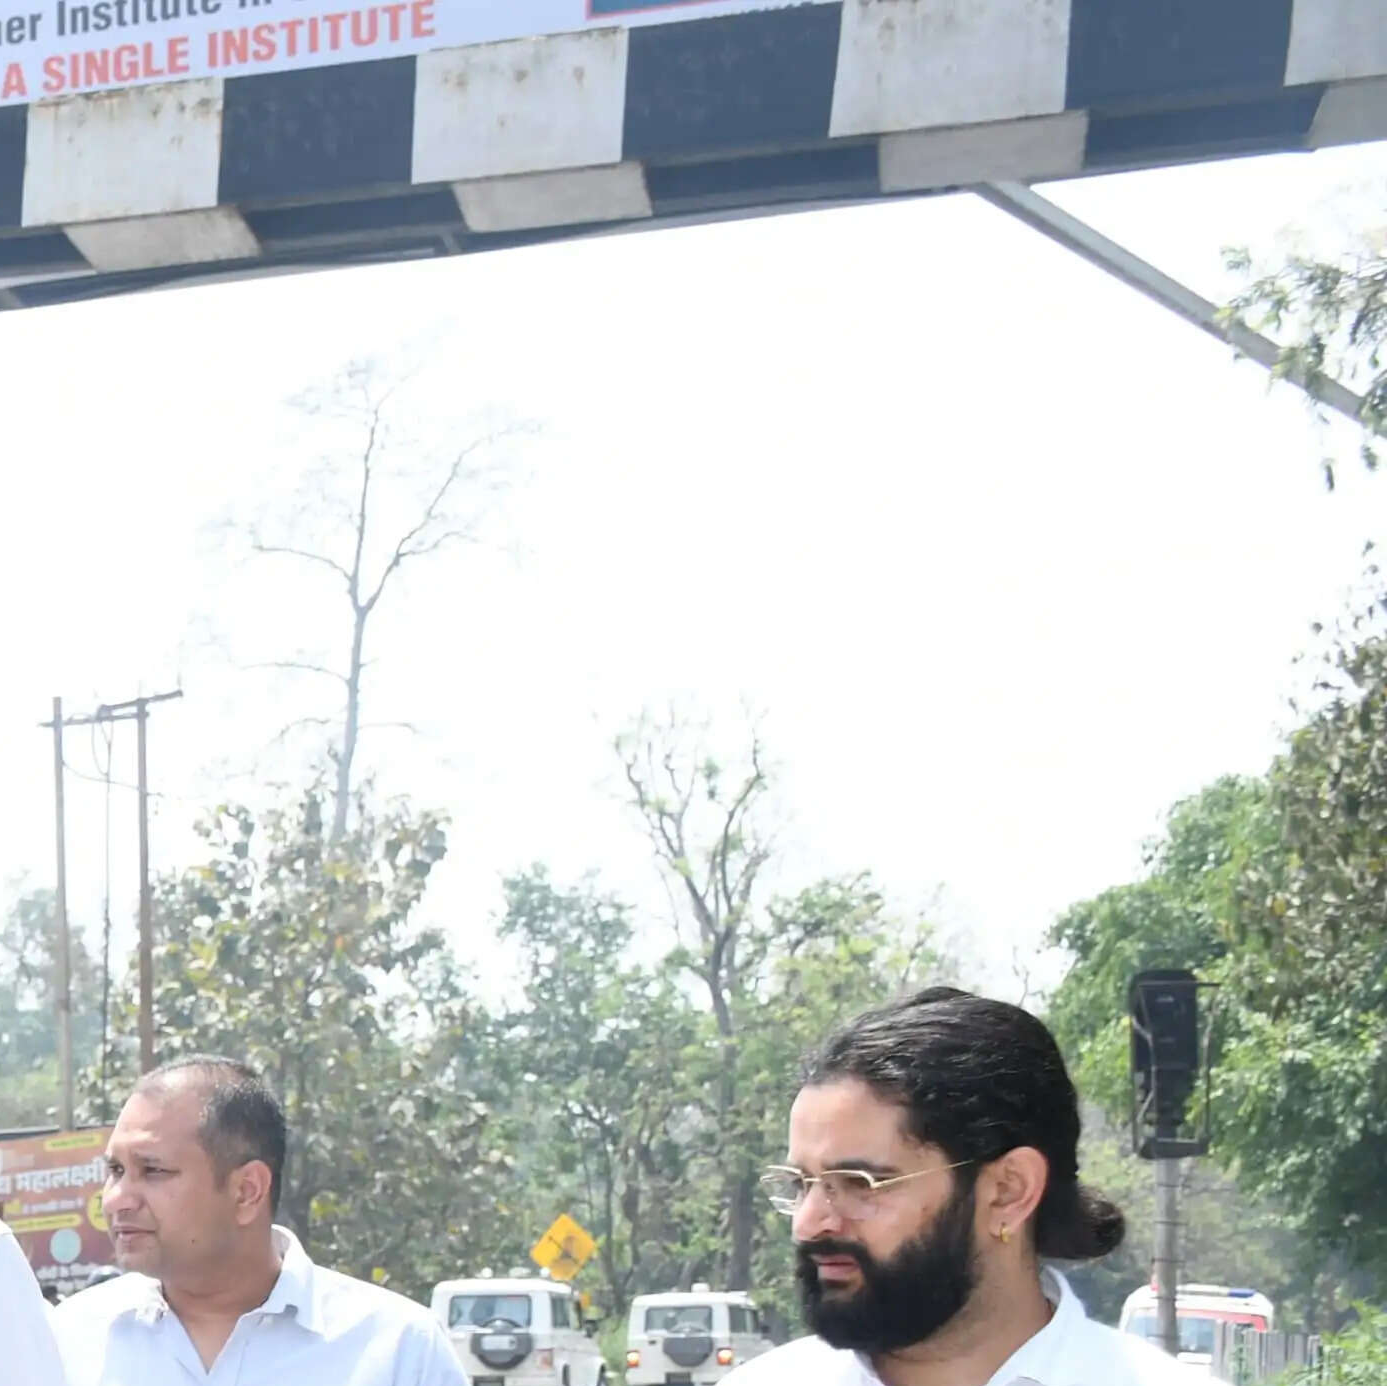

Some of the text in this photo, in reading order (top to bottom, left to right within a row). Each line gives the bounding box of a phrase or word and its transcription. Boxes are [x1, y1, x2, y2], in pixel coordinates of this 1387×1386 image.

[1, 62, 27, 99] A
[42, 37, 190, 94] SINGLE
[207, 1, 437, 66] INSTITUTE
